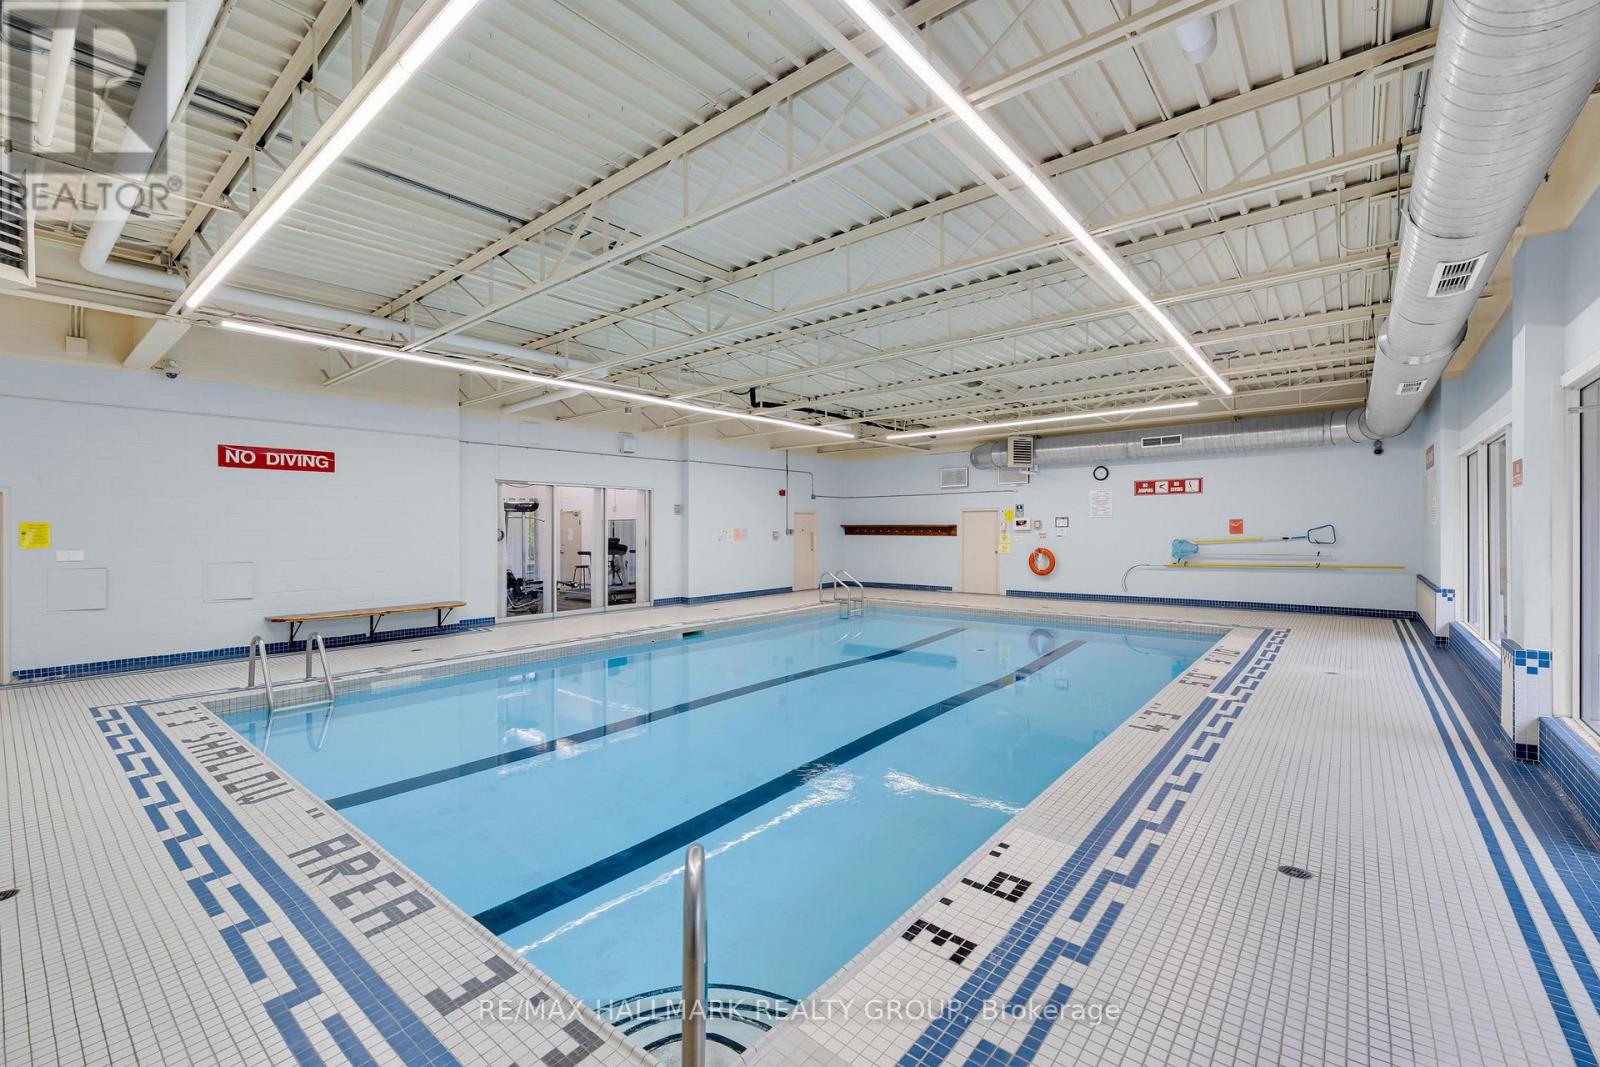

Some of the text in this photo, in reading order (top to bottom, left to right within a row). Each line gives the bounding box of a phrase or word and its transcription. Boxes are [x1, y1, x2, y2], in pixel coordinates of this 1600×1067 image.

[225, 449, 329, 469] NO DIVING
[181, 732, 295, 806] SHALLOW
[288, 833, 436, 939] AREA
